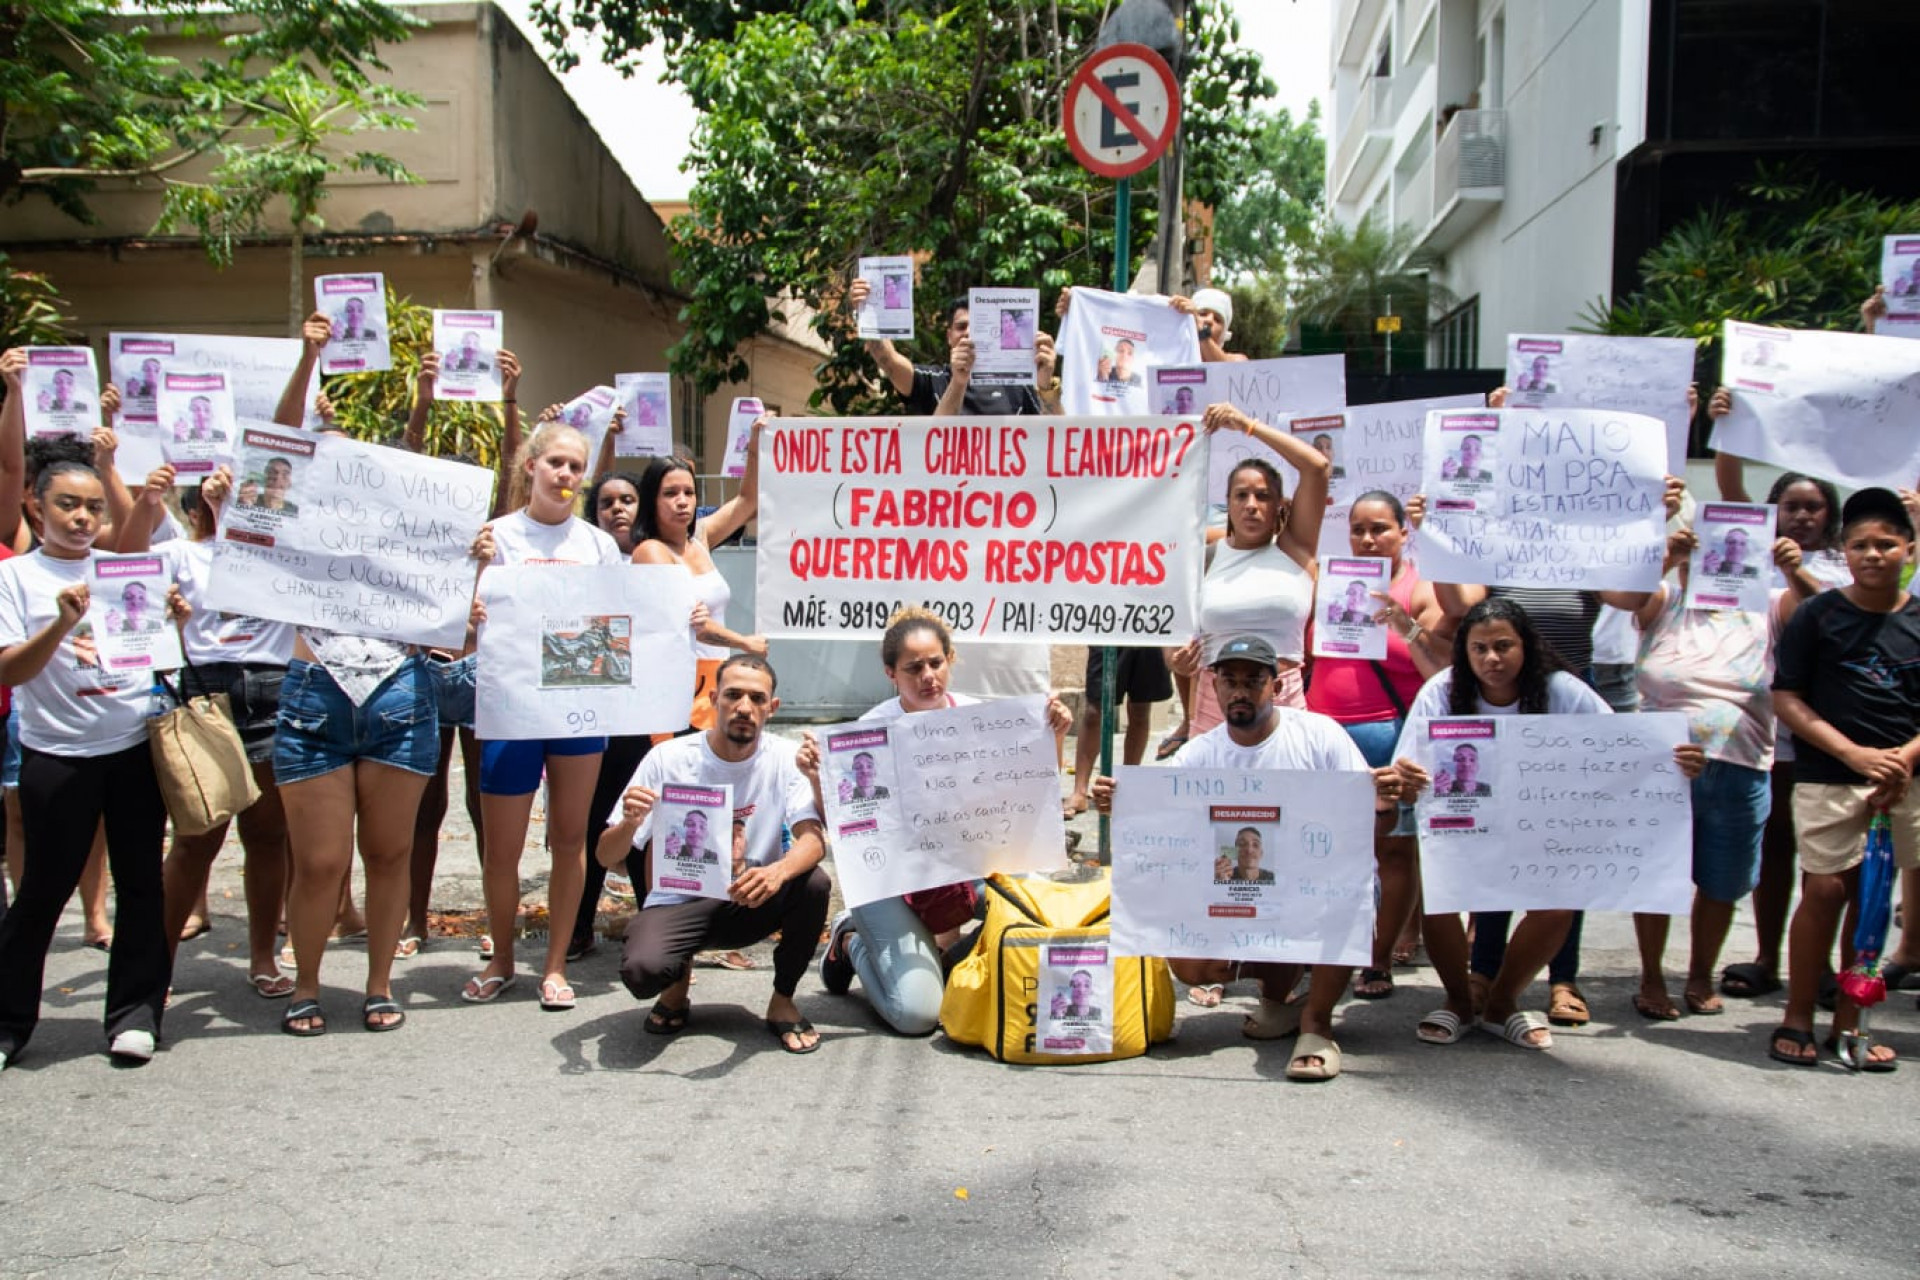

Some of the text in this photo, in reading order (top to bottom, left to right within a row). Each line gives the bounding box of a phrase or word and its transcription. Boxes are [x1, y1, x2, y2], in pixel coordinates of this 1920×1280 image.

[1101, 73, 1139, 148] E
[1229, 369, 1280, 404] NÃO
[772, 422, 1196, 480] ONDE ESTÁ CHARLES LEANDRO?
[336, 454, 488, 514] NÃO VAMOS
[1508, 458, 1636, 495] UM PRA
[317, 494, 368, 527] NOS
[319, 526, 452, 567] QUEREMOS
[1452, 535, 1494, 560] NÃO
[1504, 545, 1578, 565] VAMOS
[327, 558, 468, 601] ENCONTRAR
[272, 577, 443, 623] CHARLES LEANDRO
[1003, 601, 1043, 633] PAI:
[1049, 603, 1174, 635] 97949-7632
[566, 709, 597, 733] 99
[912, 716, 1032, 741] Uma Pessoa
[1517, 757, 1675, 780] pode fazer a
[666, 791, 721, 803] DESAPARECIDO
[1629, 787, 1686, 804] entre
[1214, 810, 1277, 819] DESAPARECIDO
[1517, 818, 1535, 832] a
[1545, 817, 1618, 834] espera
